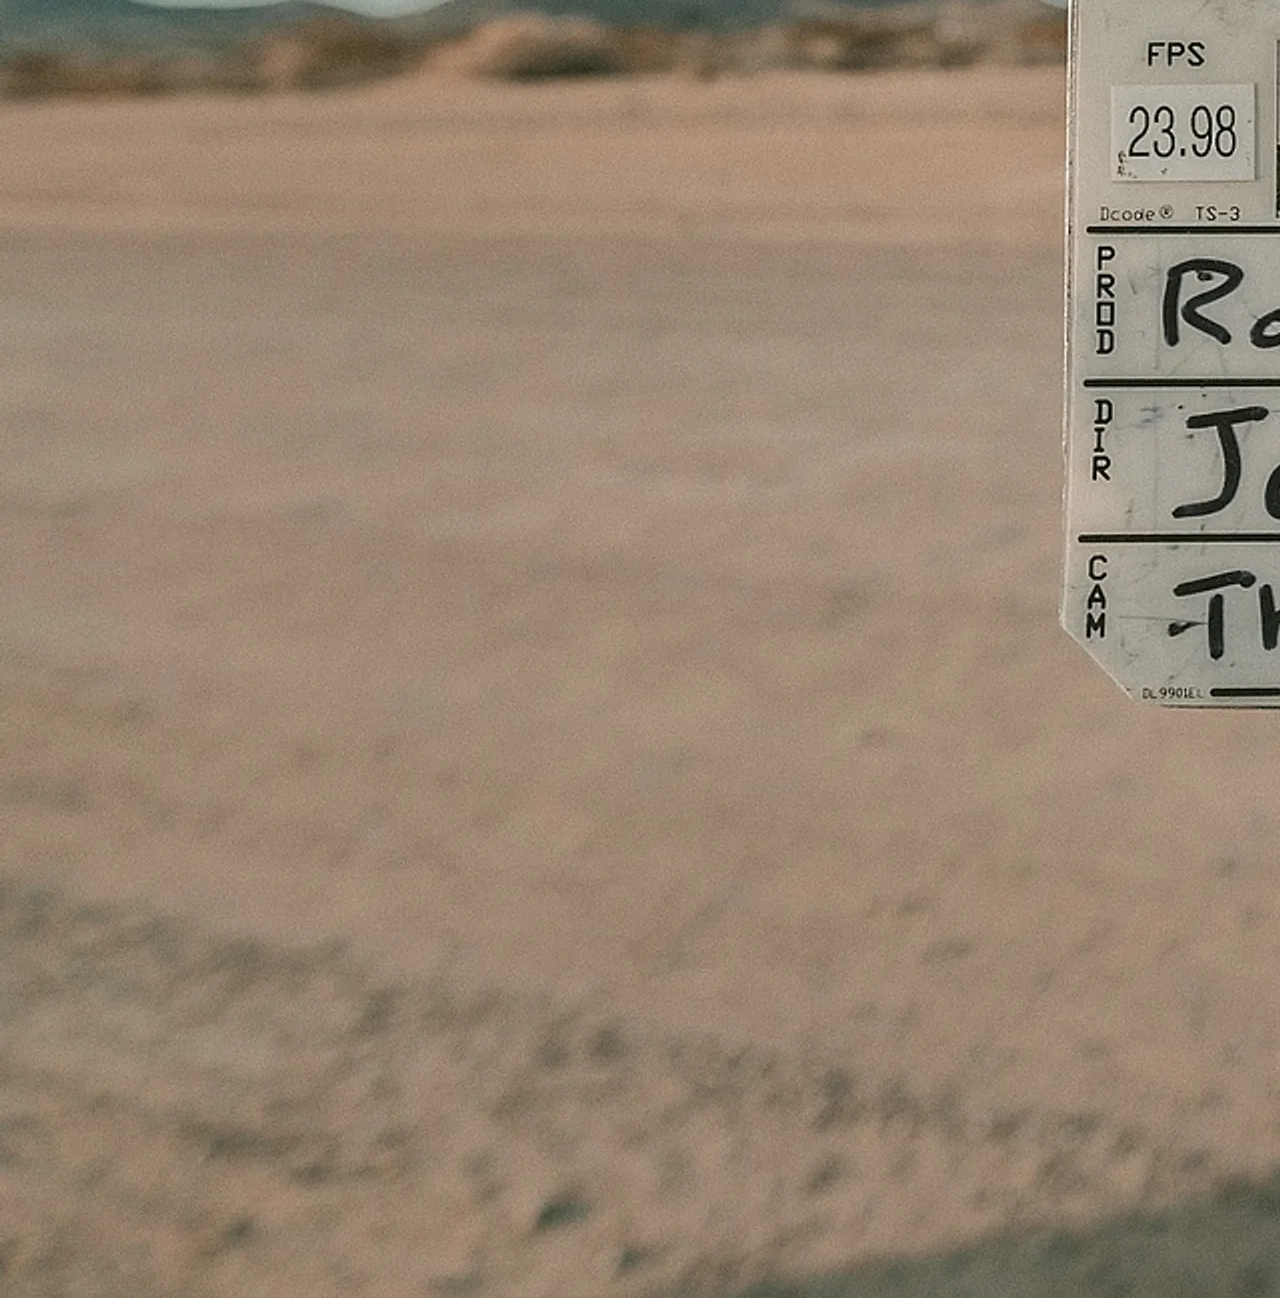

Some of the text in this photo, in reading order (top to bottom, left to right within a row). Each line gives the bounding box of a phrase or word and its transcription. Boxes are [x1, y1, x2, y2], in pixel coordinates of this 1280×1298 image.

[1147, 42, 1205, 67] FPS
[1128, 104, 1236, 157] 23.98
[1195, 205, 1241, 222] TS-3
[1096, 246, 1115, 355] PROD
[1092, 400, 1112, 481] DIR
[1086, 556, 1108, 639] CAM
